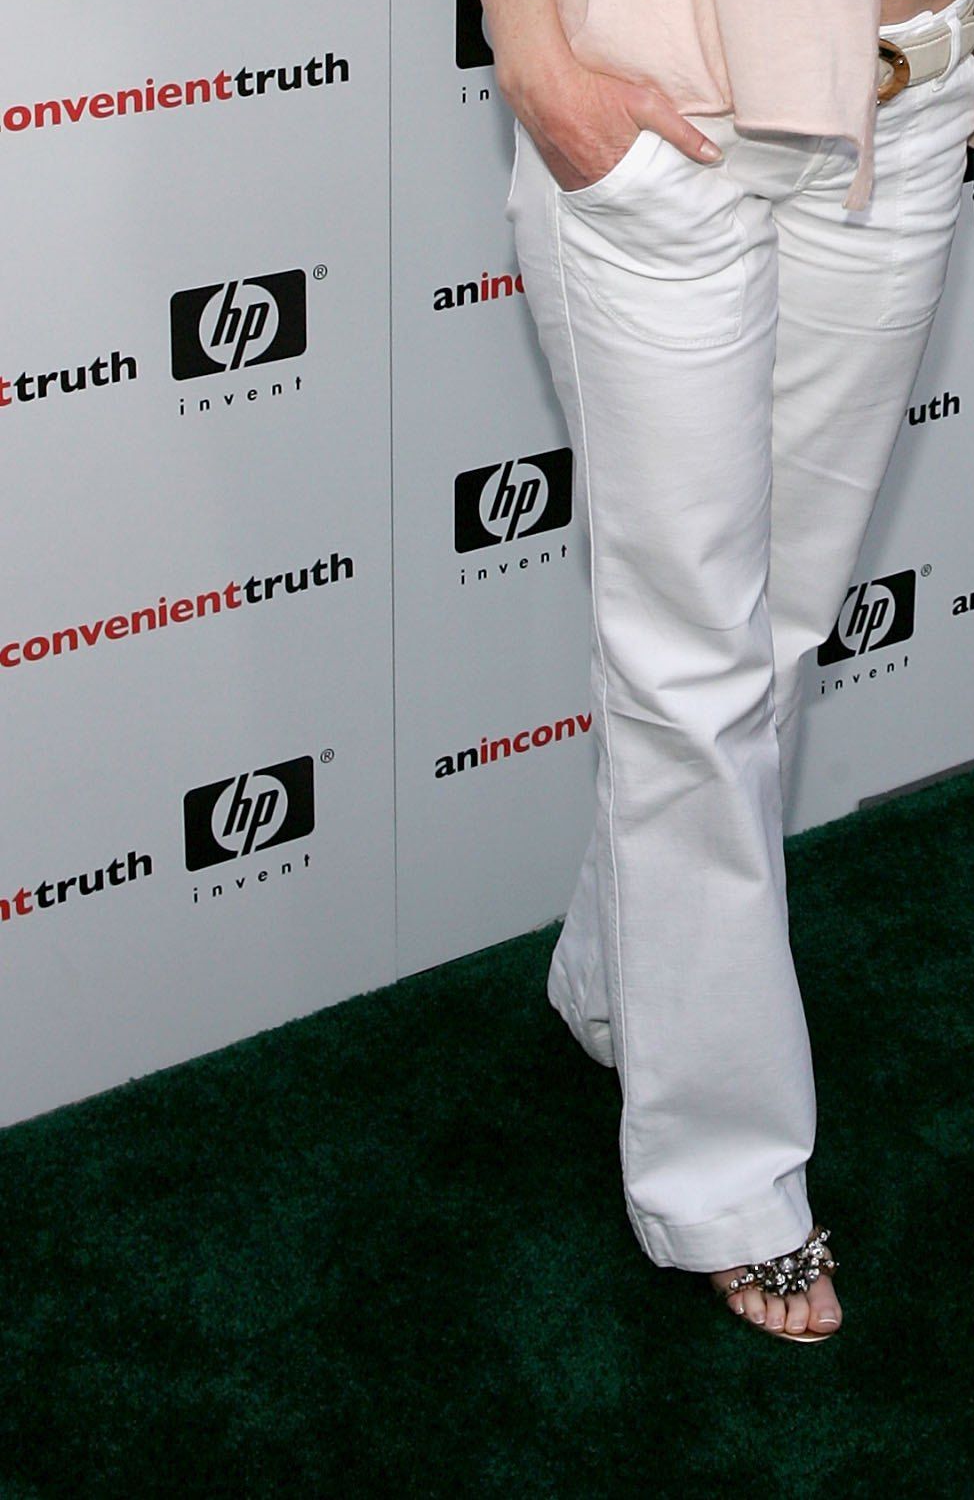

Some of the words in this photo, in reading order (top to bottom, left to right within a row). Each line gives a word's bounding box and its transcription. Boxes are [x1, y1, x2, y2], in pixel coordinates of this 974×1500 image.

[0, 53, 349, 132] onvenienttruth
[180, 377, 301, 415] invent
[461, 545, 567, 585] invent
[821, 655, 908, 694] invent
[193, 854, 310, 903] invent
